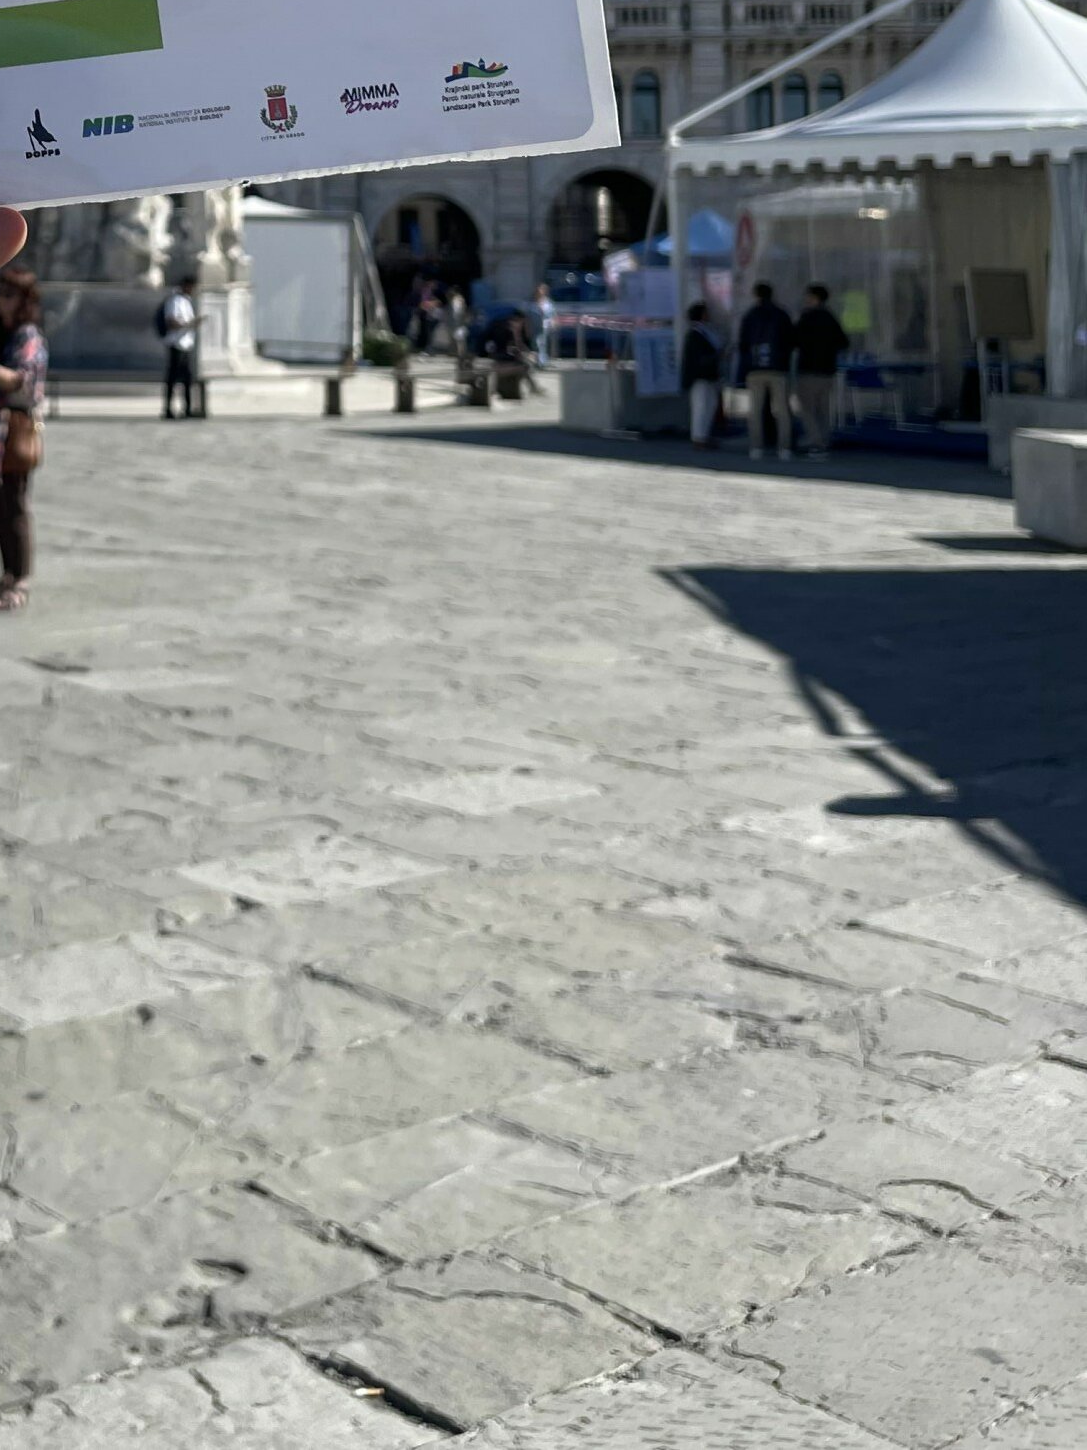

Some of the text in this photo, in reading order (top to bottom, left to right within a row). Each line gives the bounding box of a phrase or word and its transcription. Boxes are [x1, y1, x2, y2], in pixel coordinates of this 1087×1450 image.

[344, 82, 400, 101] MIMMA
[344, 99, 400, 114] Dreams
[443, 102, 476, 112] Landscape
[82, 114, 135, 138] NIB
[25, 148, 61, 159] DOPPS
